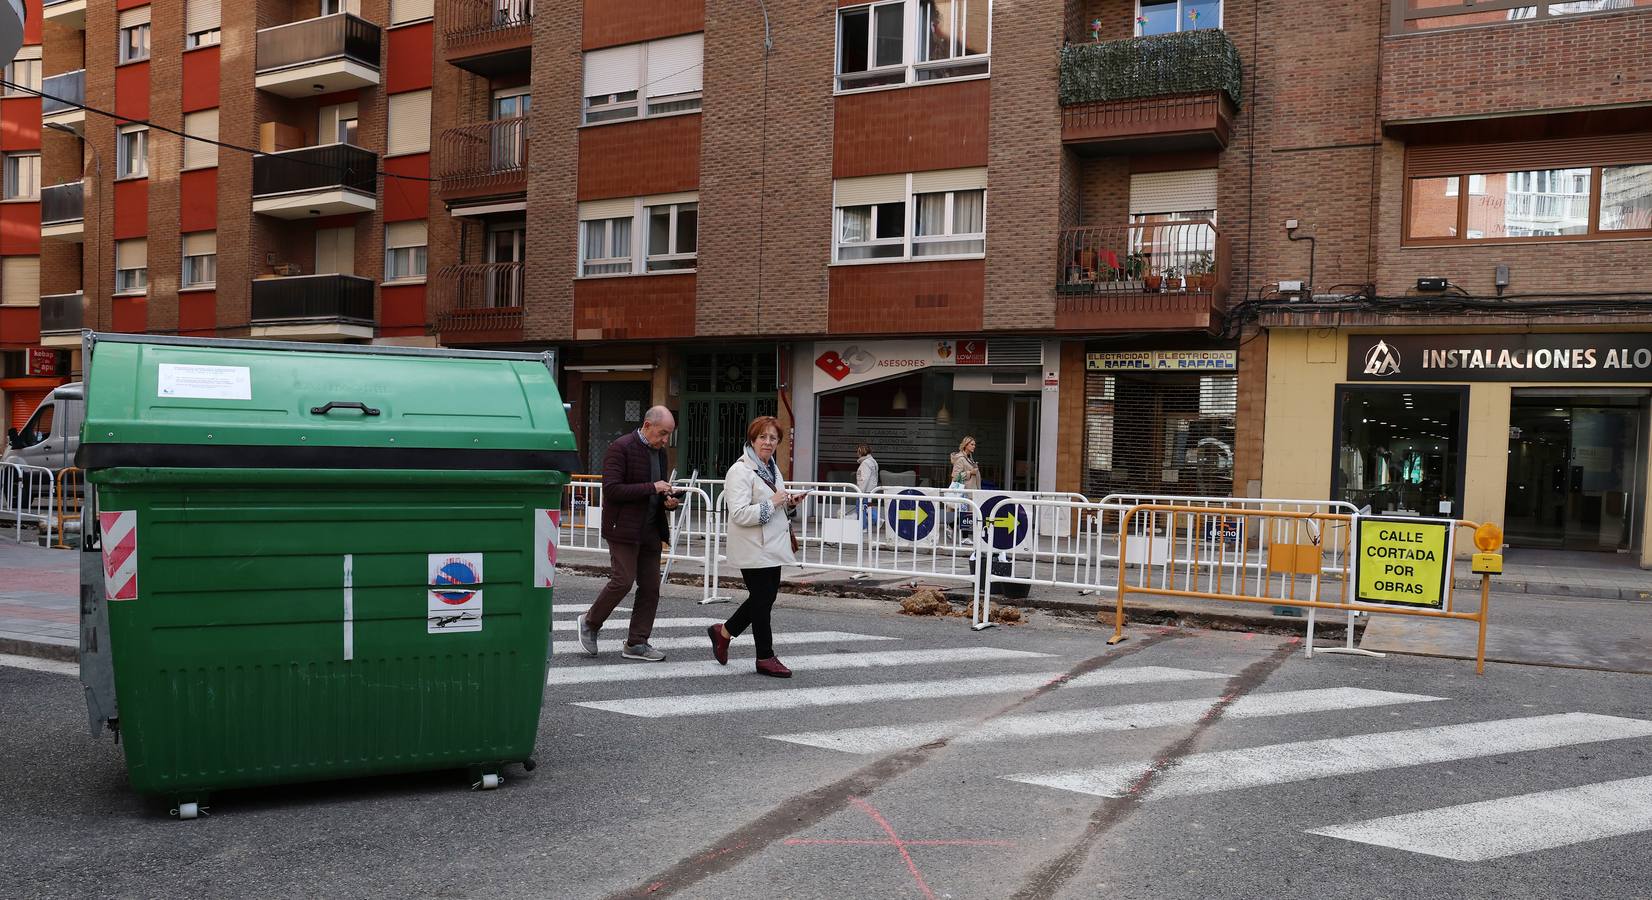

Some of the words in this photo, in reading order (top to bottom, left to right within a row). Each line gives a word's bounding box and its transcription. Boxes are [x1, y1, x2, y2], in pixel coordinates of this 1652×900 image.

[1088, 352, 1150, 360] ELECTRICIDAD
[1157, 351, 1233, 360] ELECTRICIDAD
[1422, 349, 1597, 369] INSTALACIONES
[877, 359, 926, 368] ASESORES
[1088, 360, 1100, 369] A.
[1104, 360, 1150, 368] RAFAEL
[1157, 360, 1171, 368] A.
[1178, 360, 1234, 368] RAFAEL
[1379, 530, 1423, 543] CALLE
[1367, 546, 1435, 562] CORTADA
[1385, 564, 1414, 577] POR
[1374, 581, 1423, 595] OBRAS
